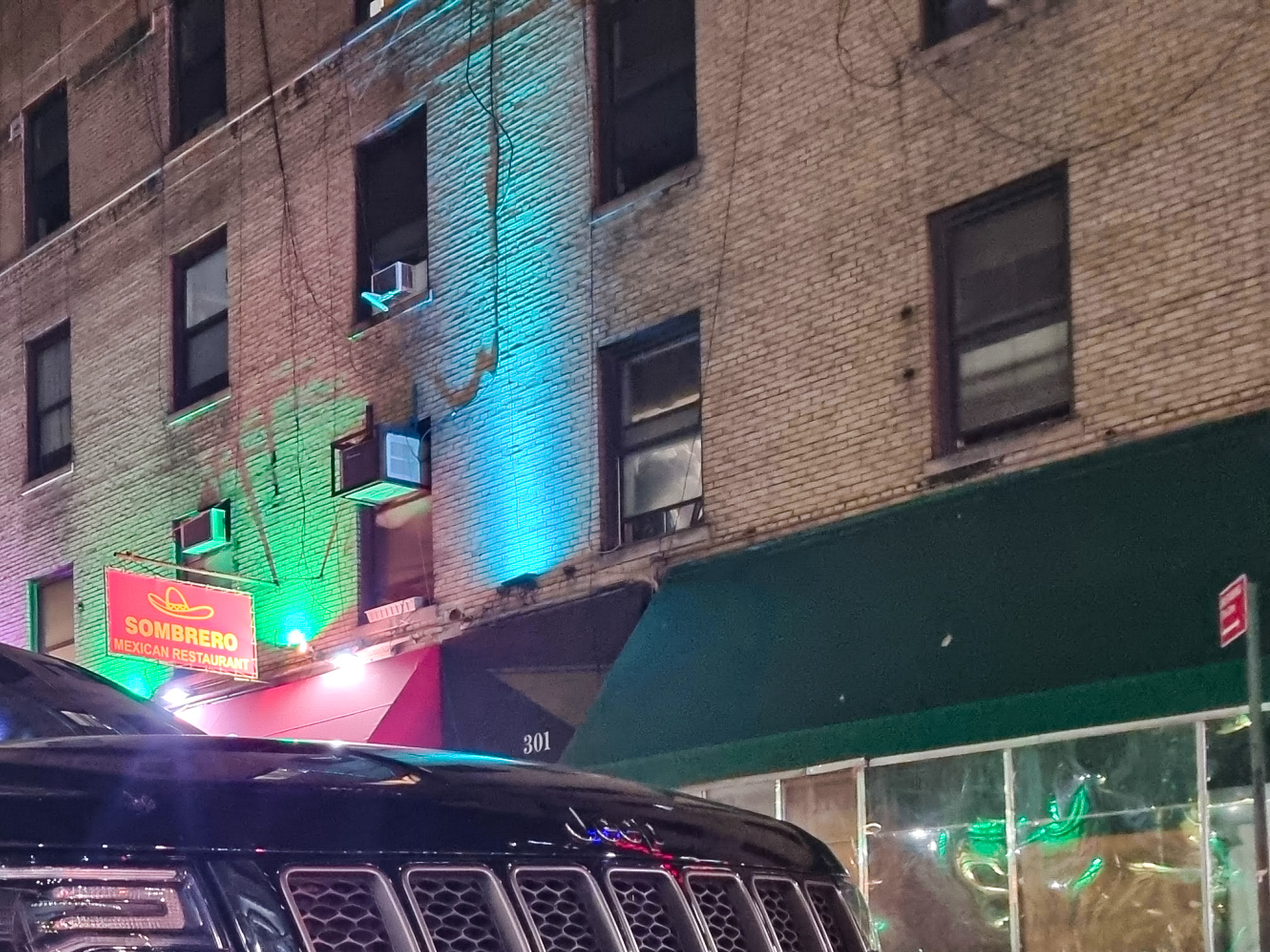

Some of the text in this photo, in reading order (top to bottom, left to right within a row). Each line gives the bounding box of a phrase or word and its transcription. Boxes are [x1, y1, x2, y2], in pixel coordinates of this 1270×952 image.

[125, 615, 238, 652] SOMBRERO
[114, 638, 250, 671] MEXICAN RESTAURANT
[523, 731, 550, 754] 301
